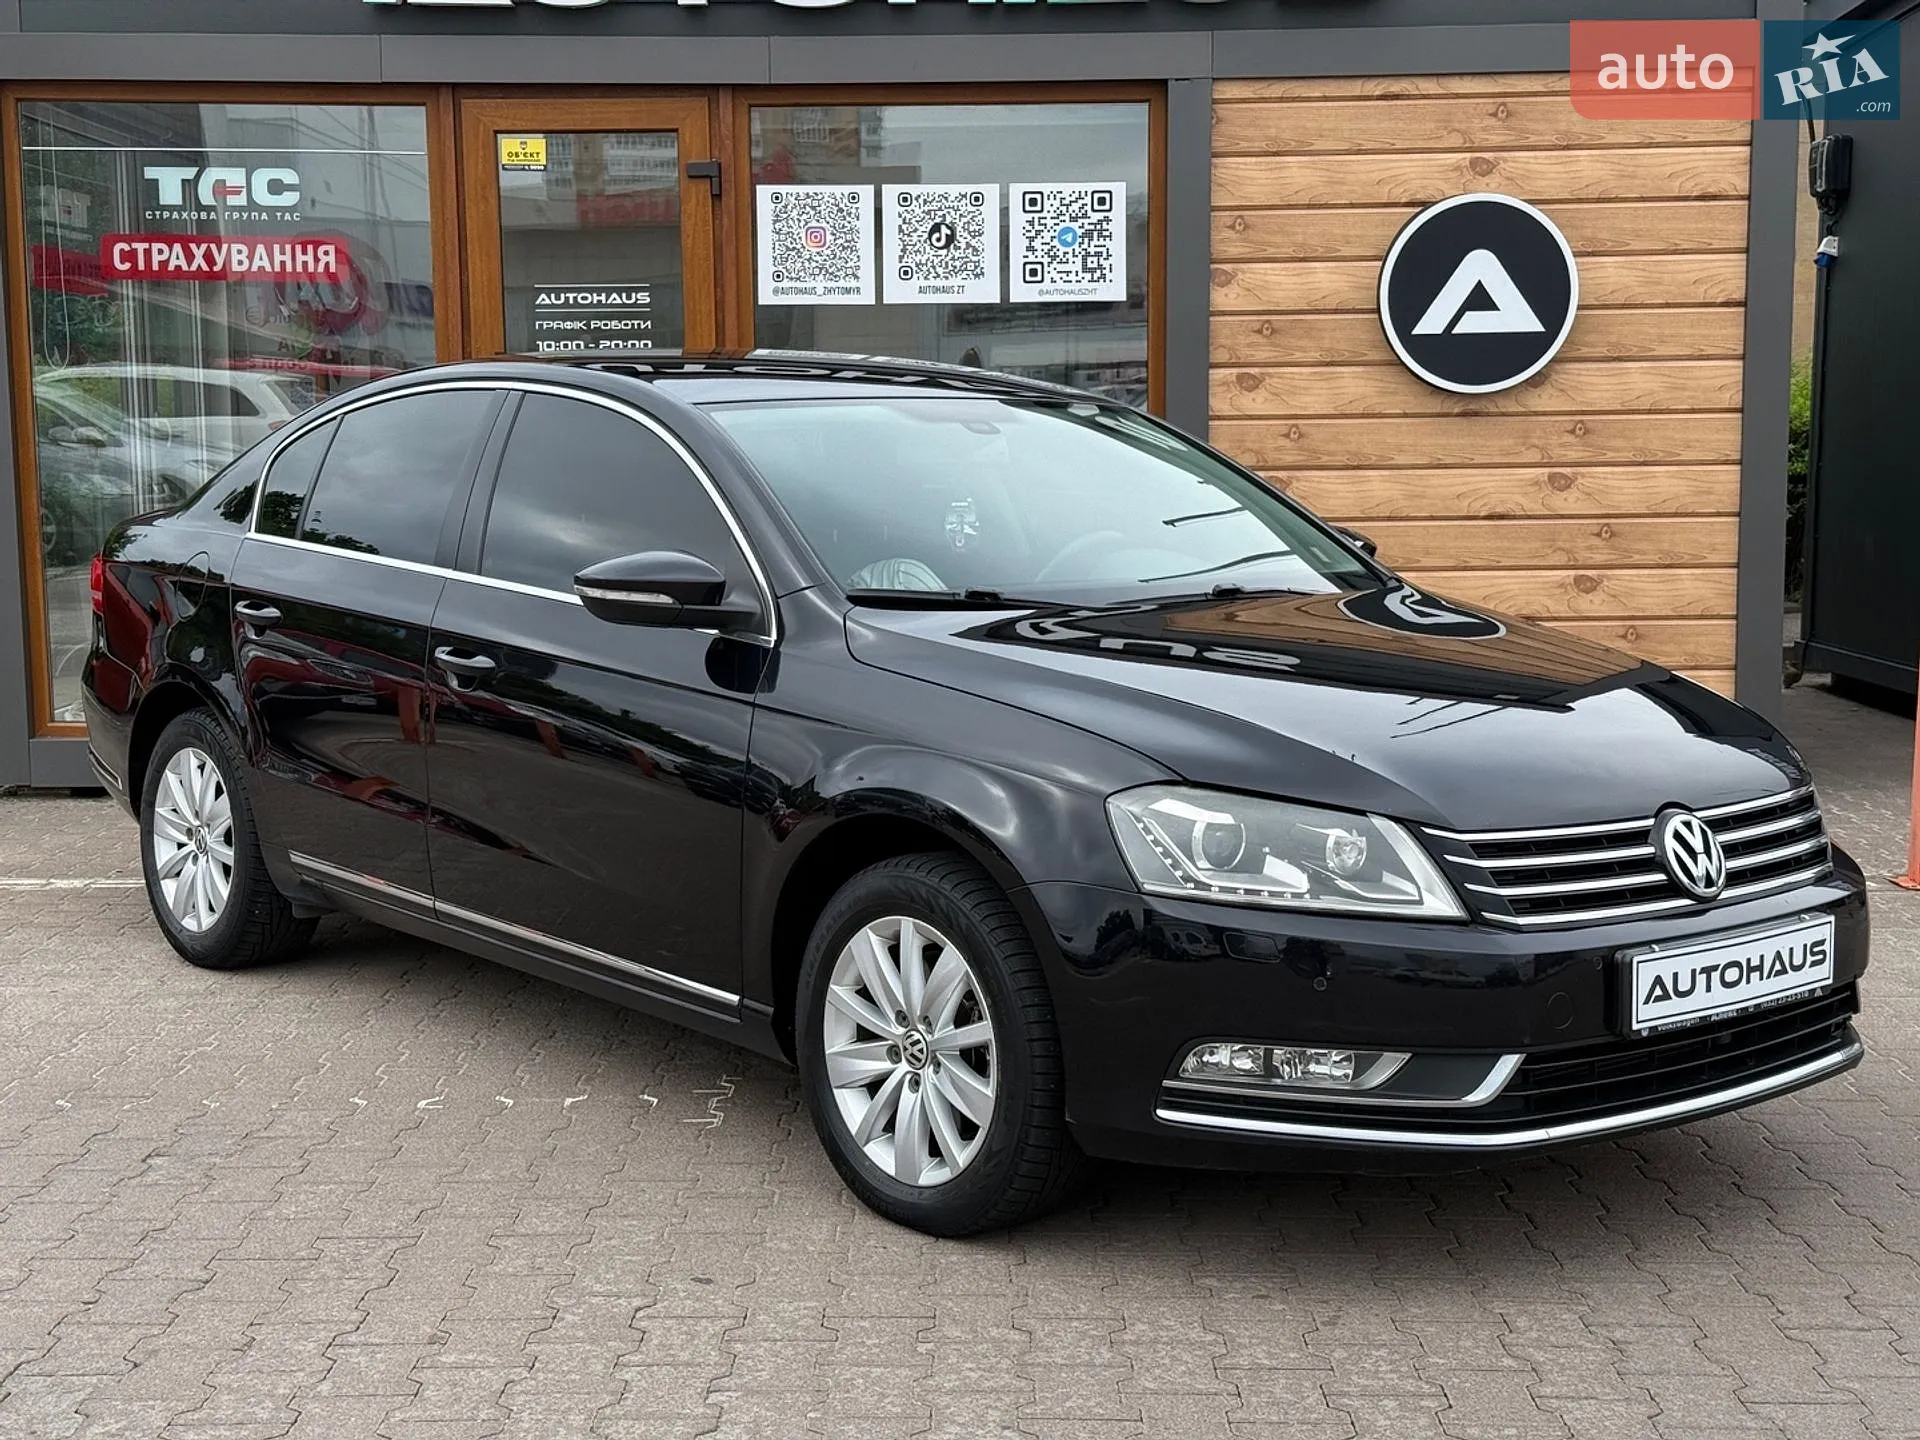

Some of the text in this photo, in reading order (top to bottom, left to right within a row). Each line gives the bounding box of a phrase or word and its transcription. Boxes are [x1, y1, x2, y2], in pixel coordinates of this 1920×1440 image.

[145, 210, 301, 221] СТРАХОВА ГРУПА ТАС
[112, 242, 337, 273] СТРАХУВАННЯ
[772, 286, 861, 297] @AUTOHAUS_ZHYTOMYR
[918, 285, 965, 294] AUTOHAUS ZT
[1038, 288, 1098, 297] @AUTOHAUSZHT
[535, 292, 651, 304] AUTOHAUS
[535, 320, 652, 330] ГРАФІК РОБОТИ
[536, 340, 585, 352] 10:00
[599, 340, 652, 349] 20:00
[1642, 938, 1828, 1006] AUTOHAUS
